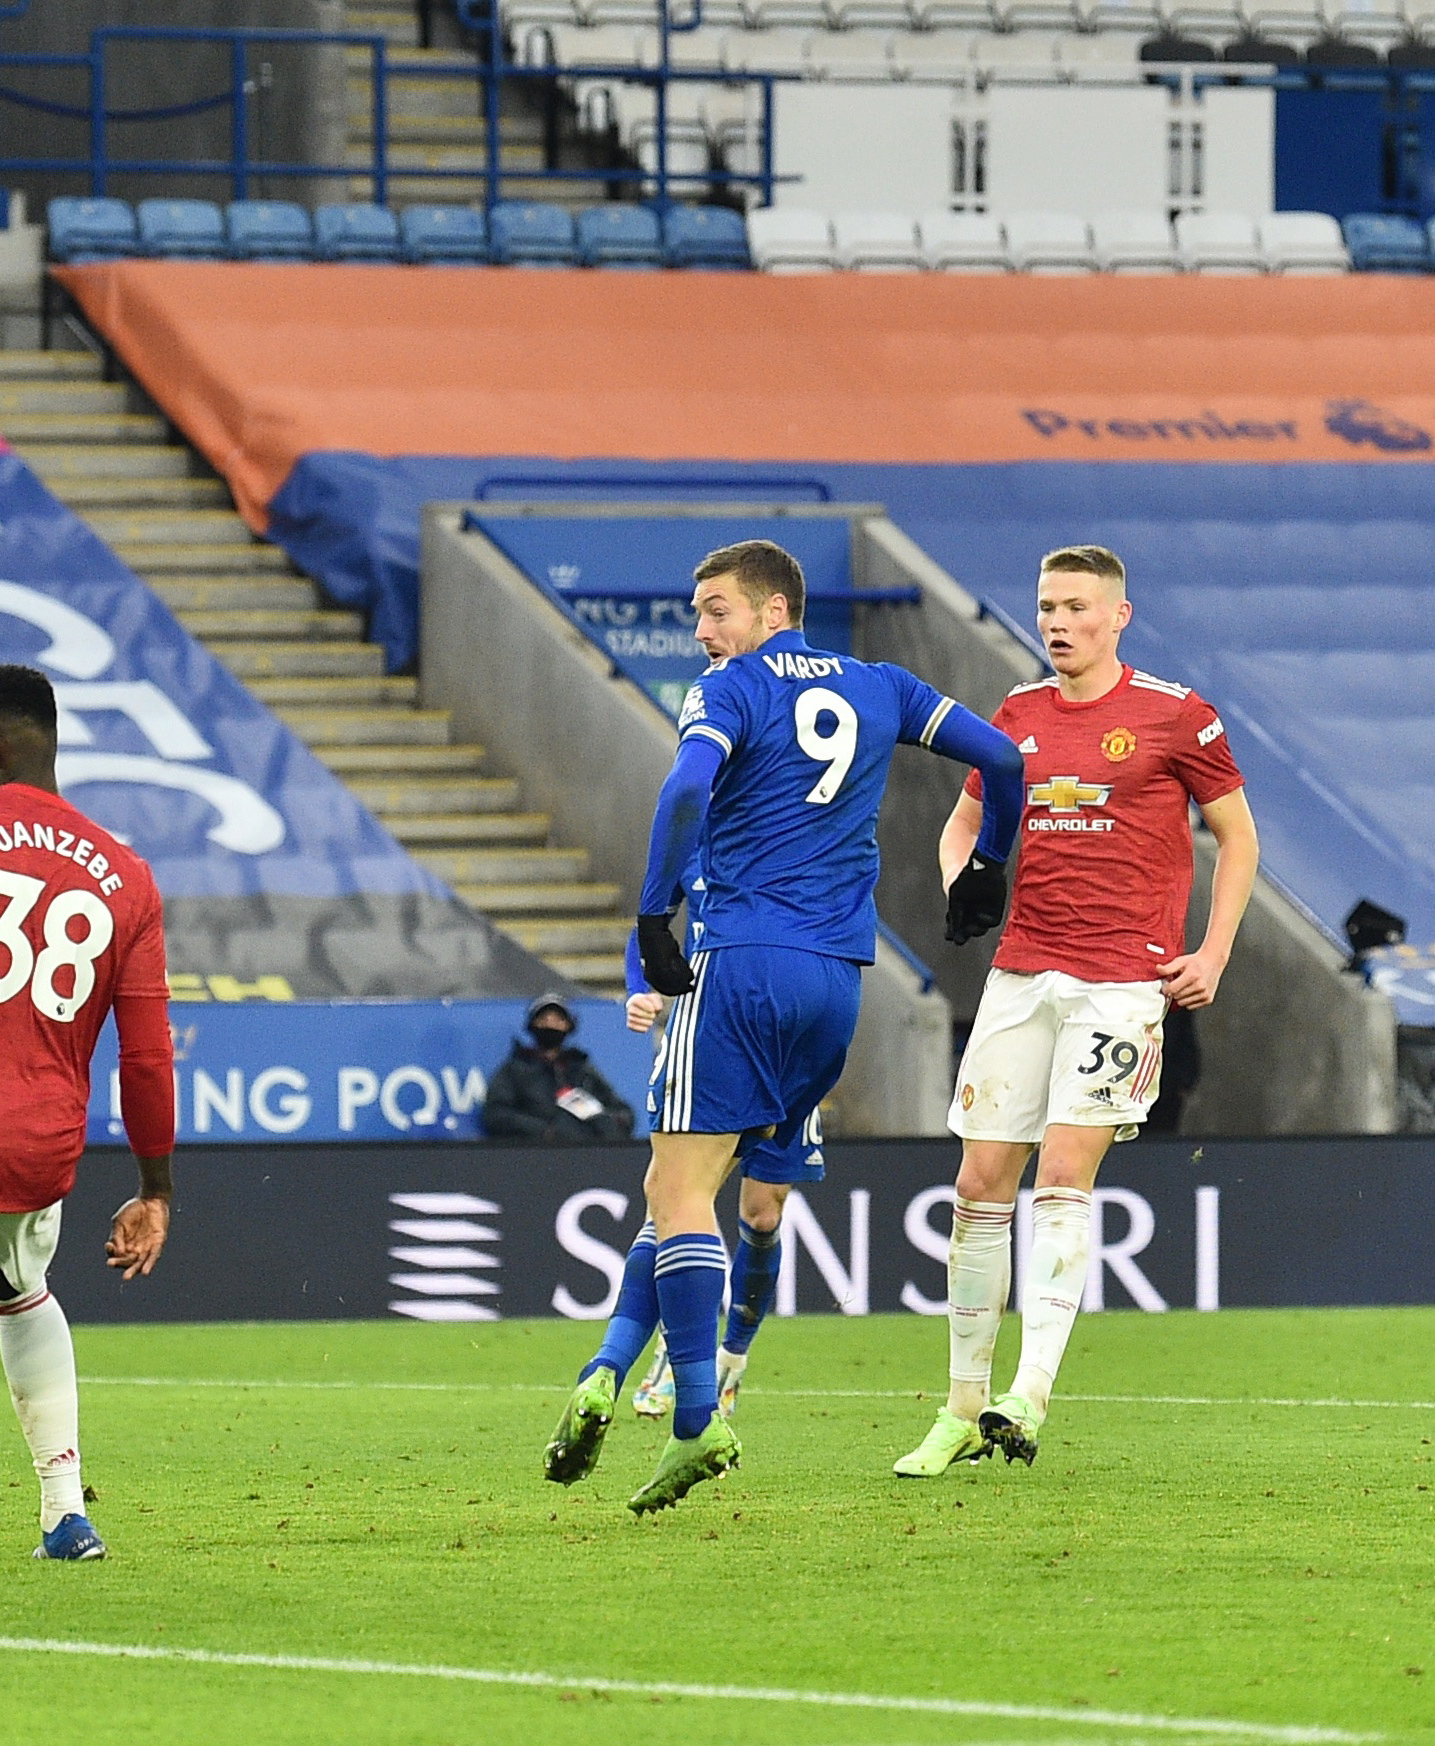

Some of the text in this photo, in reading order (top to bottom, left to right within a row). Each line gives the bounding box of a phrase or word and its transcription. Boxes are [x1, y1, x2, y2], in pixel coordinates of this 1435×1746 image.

[1021, 408, 1299, 441] Premier
[606, 629, 706, 658] STADIU
[762, 652, 845, 680] VARDY
[794, 686, 859, 805] 9
[1027, 817, 1116, 832] CHEVROLET
[1077, 1031, 1140, 1085] 39
[337, 1064, 489, 1132] POW
